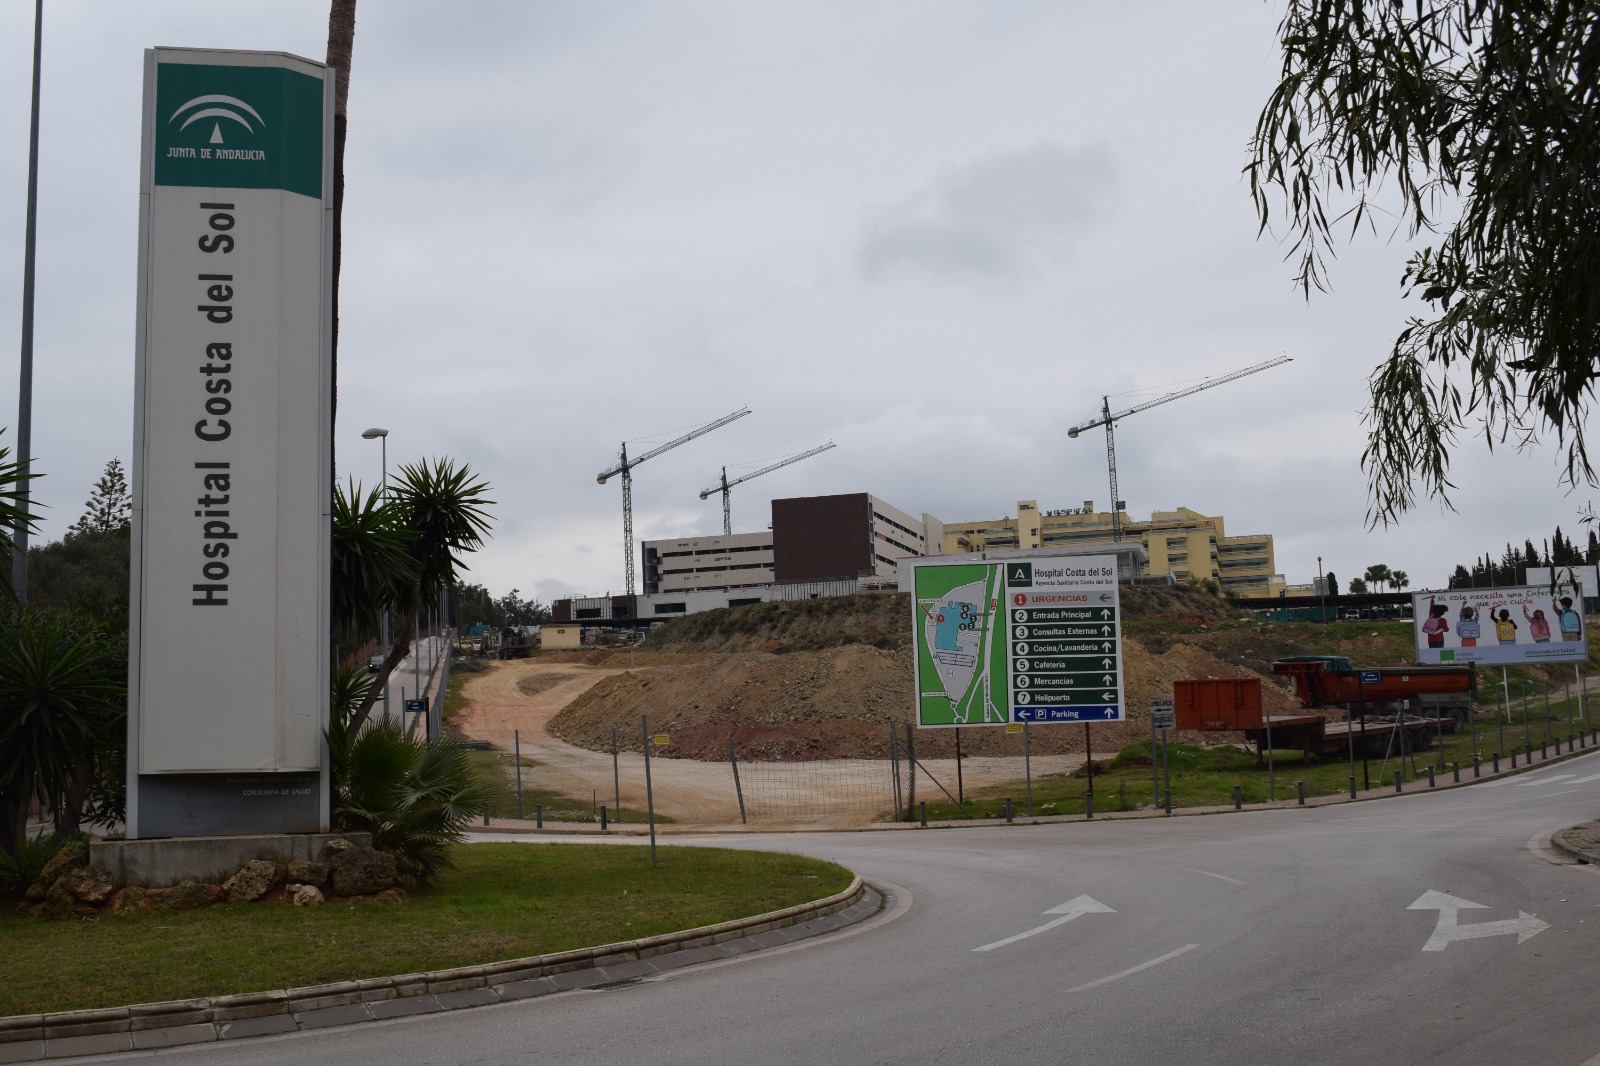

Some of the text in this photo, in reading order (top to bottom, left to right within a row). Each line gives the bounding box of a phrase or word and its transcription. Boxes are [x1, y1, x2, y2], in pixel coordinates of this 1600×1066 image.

[166, 148, 196, 158] JUNTA
[200, 148, 212, 158] DE
[192, 202, 239, 606] Hospital Costa del Sol
[1034, 567, 1112, 578] Hospital Costa del Sol
[1032, 595, 1088, 603] URGENCIAS
[1470, 592, 1503, 600] necesita
[1475, 601, 1489, 610] que
[1510, 597, 1533, 605] cuide
[1061, 611, 1091, 620] Principal
[1032, 628, 1066, 636] Consultas
[1034, 694, 1070, 702] Helipuerto
[1051, 710, 1079, 718] Parking
